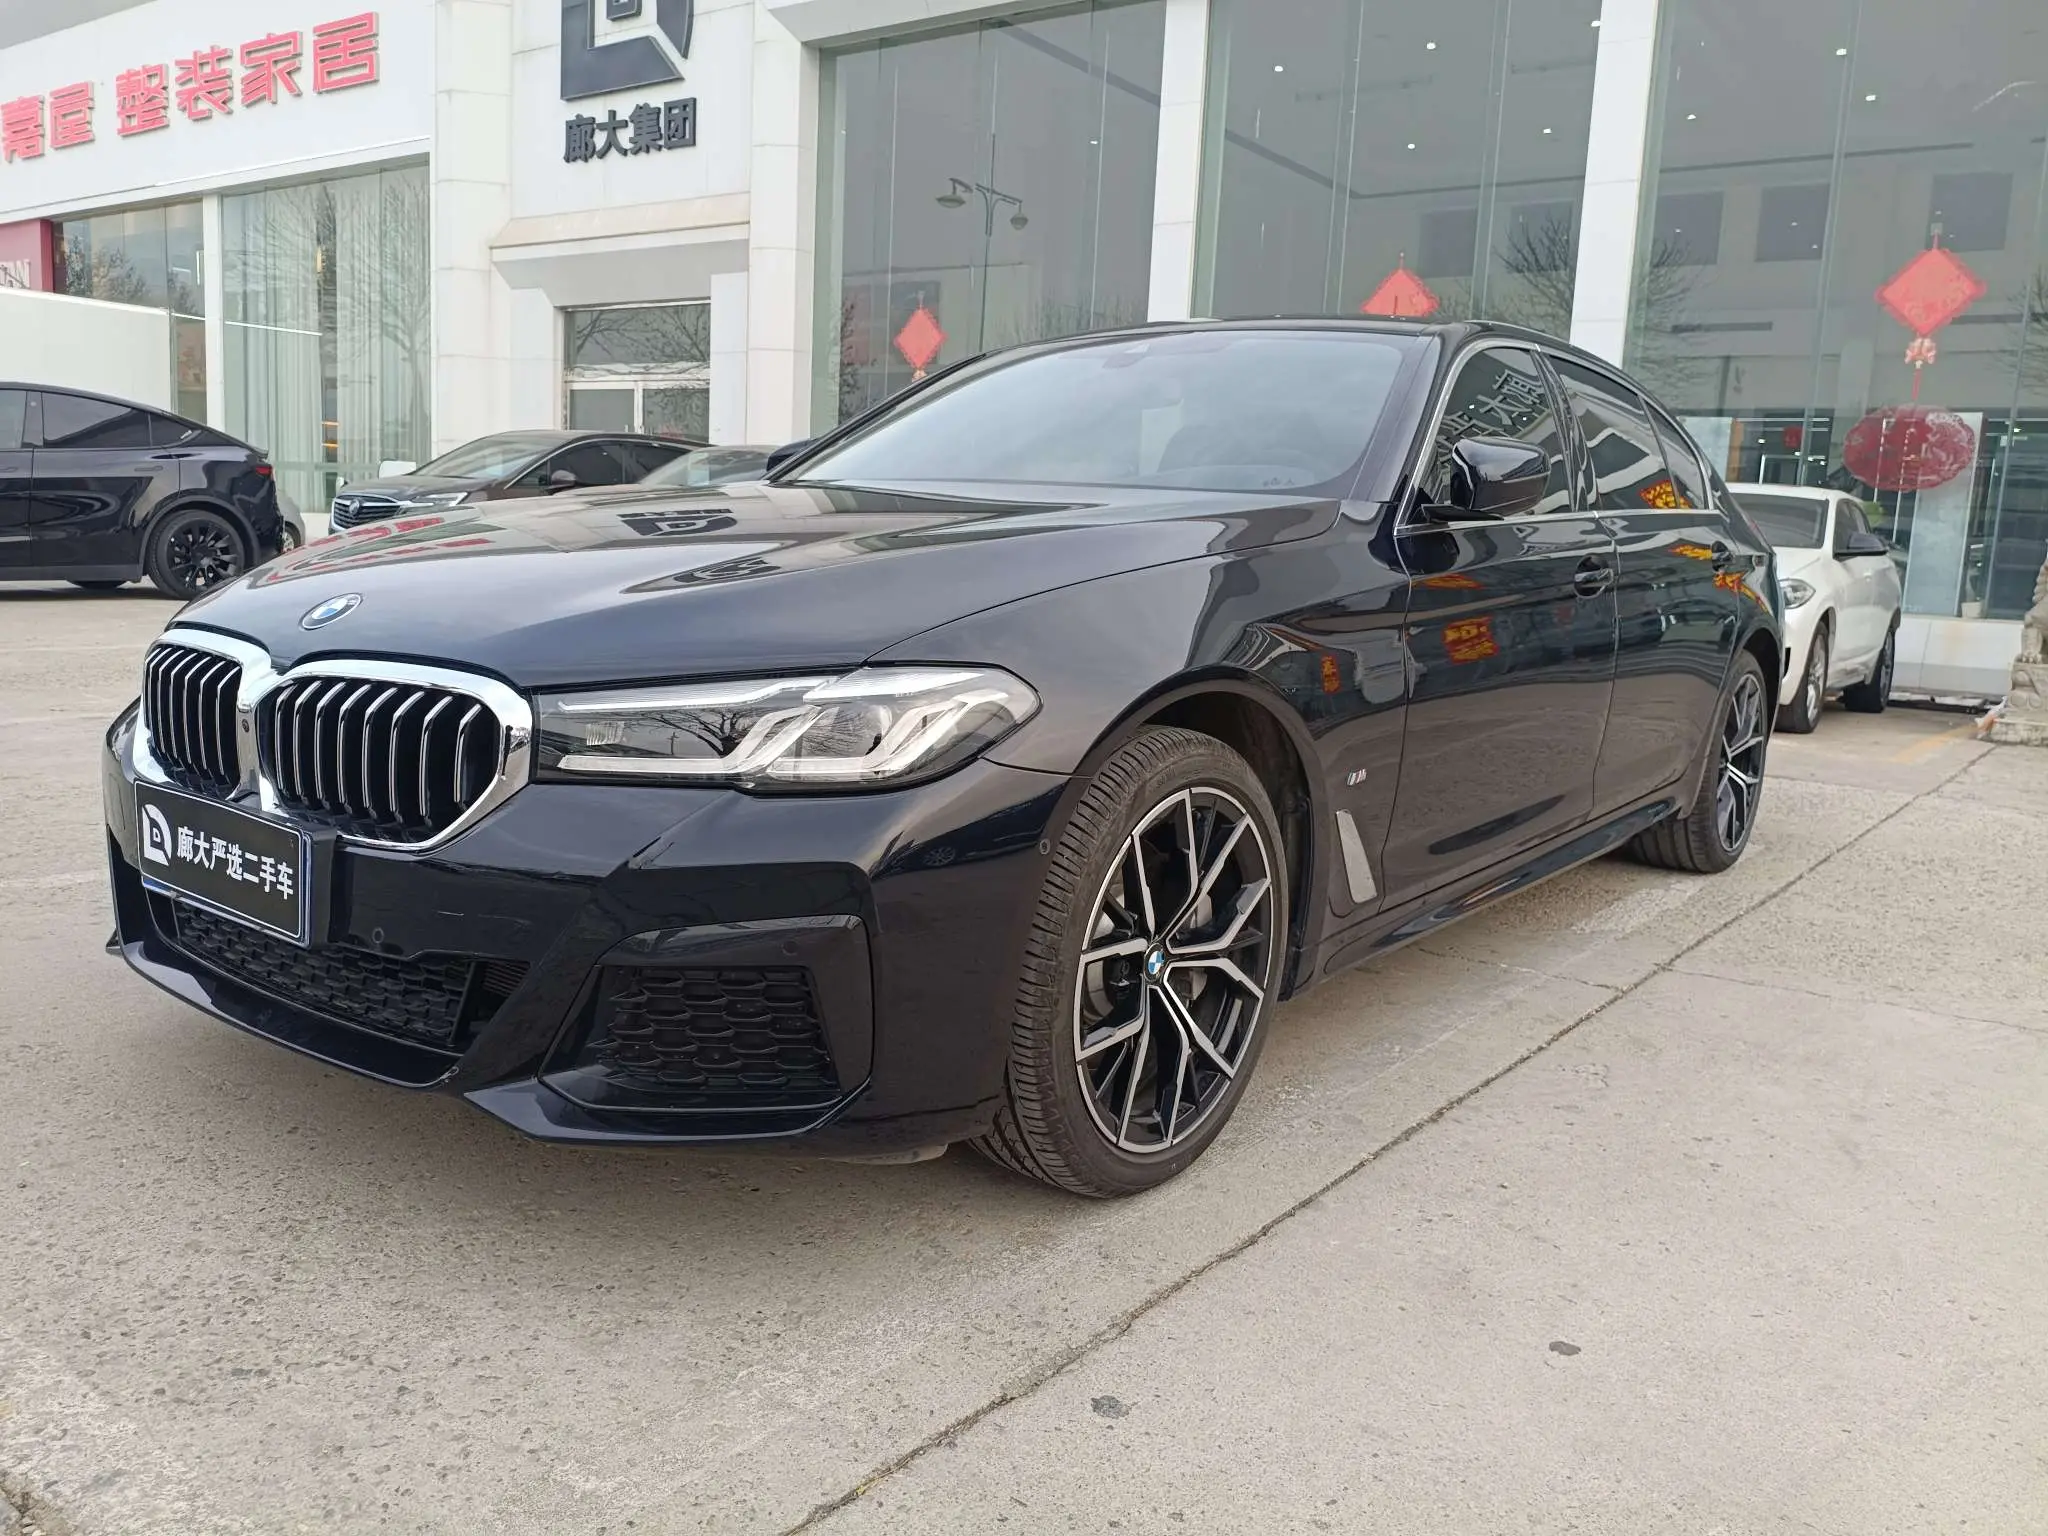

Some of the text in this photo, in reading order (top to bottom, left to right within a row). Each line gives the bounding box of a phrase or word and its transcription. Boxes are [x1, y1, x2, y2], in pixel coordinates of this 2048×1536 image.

[115, 11, 379, 137] 整装家居
[563, 97, 697, 163] 廊大集团
[176, 825, 294, 900] 廊大严选二手车
